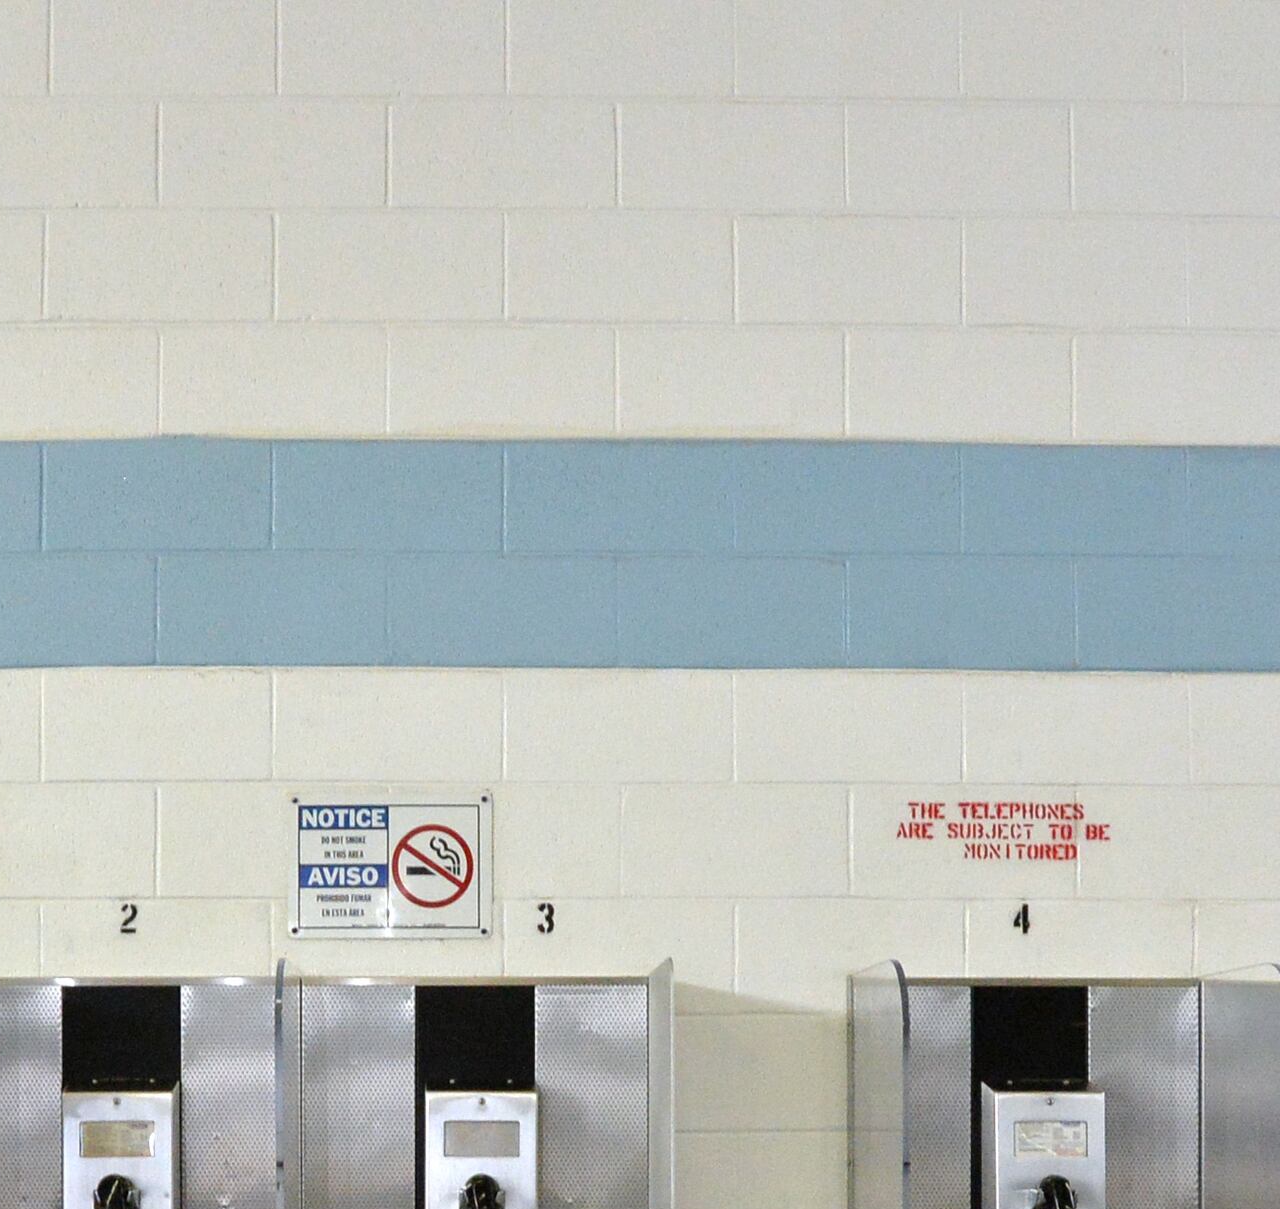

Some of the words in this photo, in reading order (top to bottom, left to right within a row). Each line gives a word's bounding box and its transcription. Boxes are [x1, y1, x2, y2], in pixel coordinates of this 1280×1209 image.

[301, 808, 386, 828] NOTICE
[908, 801, 945, 819] THE
[959, 801, 1085, 820] TELEPHONES
[321, 836, 331, 845] DO
[332, 836, 344, 845] NOT
[346, 836, 367, 845] SMOKE
[896, 822, 934, 840] ARE
[947, 823, 1034, 840] SUBJECT
[1049, 824, 1074, 840] TO
[1085, 824, 1110, 841] BE
[324, 850, 331, 859] IN
[332, 850, 347, 859] THIS
[349, 850, 365, 859] AREA
[963, 844, 1079, 861] MONITORED
[307, 866, 379, 886] AVISO
[351, 894, 372, 903] FUMAR
[120, 904, 138, 934] 2
[321, 908, 331, 918] EN
[332, 908, 347, 918] ESTA
[537, 903, 555, 935] 3
[1013, 903, 1031, 935] 4
